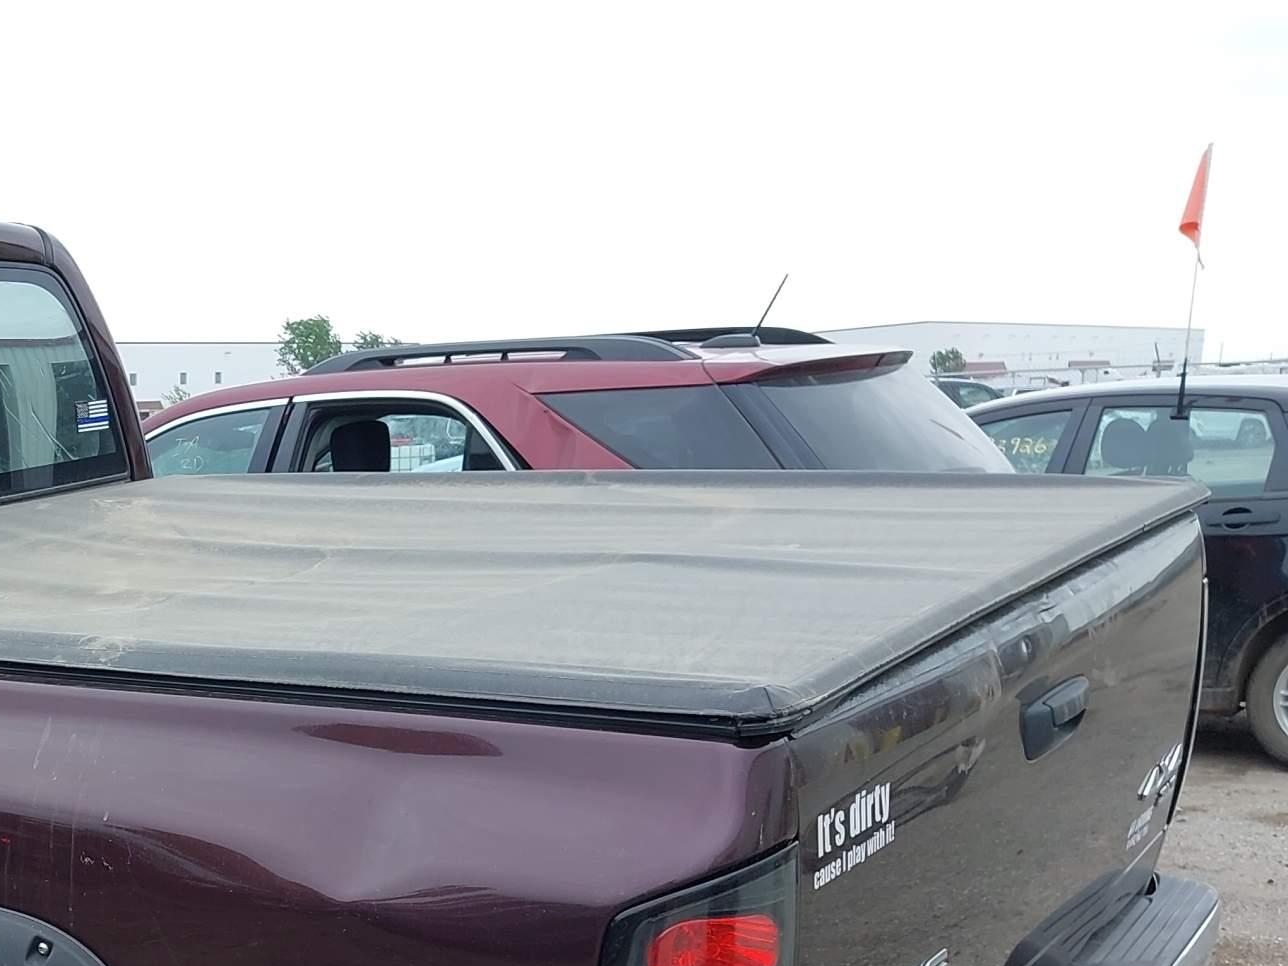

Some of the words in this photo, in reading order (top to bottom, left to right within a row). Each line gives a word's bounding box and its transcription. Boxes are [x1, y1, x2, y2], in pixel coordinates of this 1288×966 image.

[817, 807, 846, 858] It's
[849, 782, 891, 838] dirty
[813, 857, 842, 890] cause
[847, 842, 867, 872] play
[866, 828, 885, 857] with
